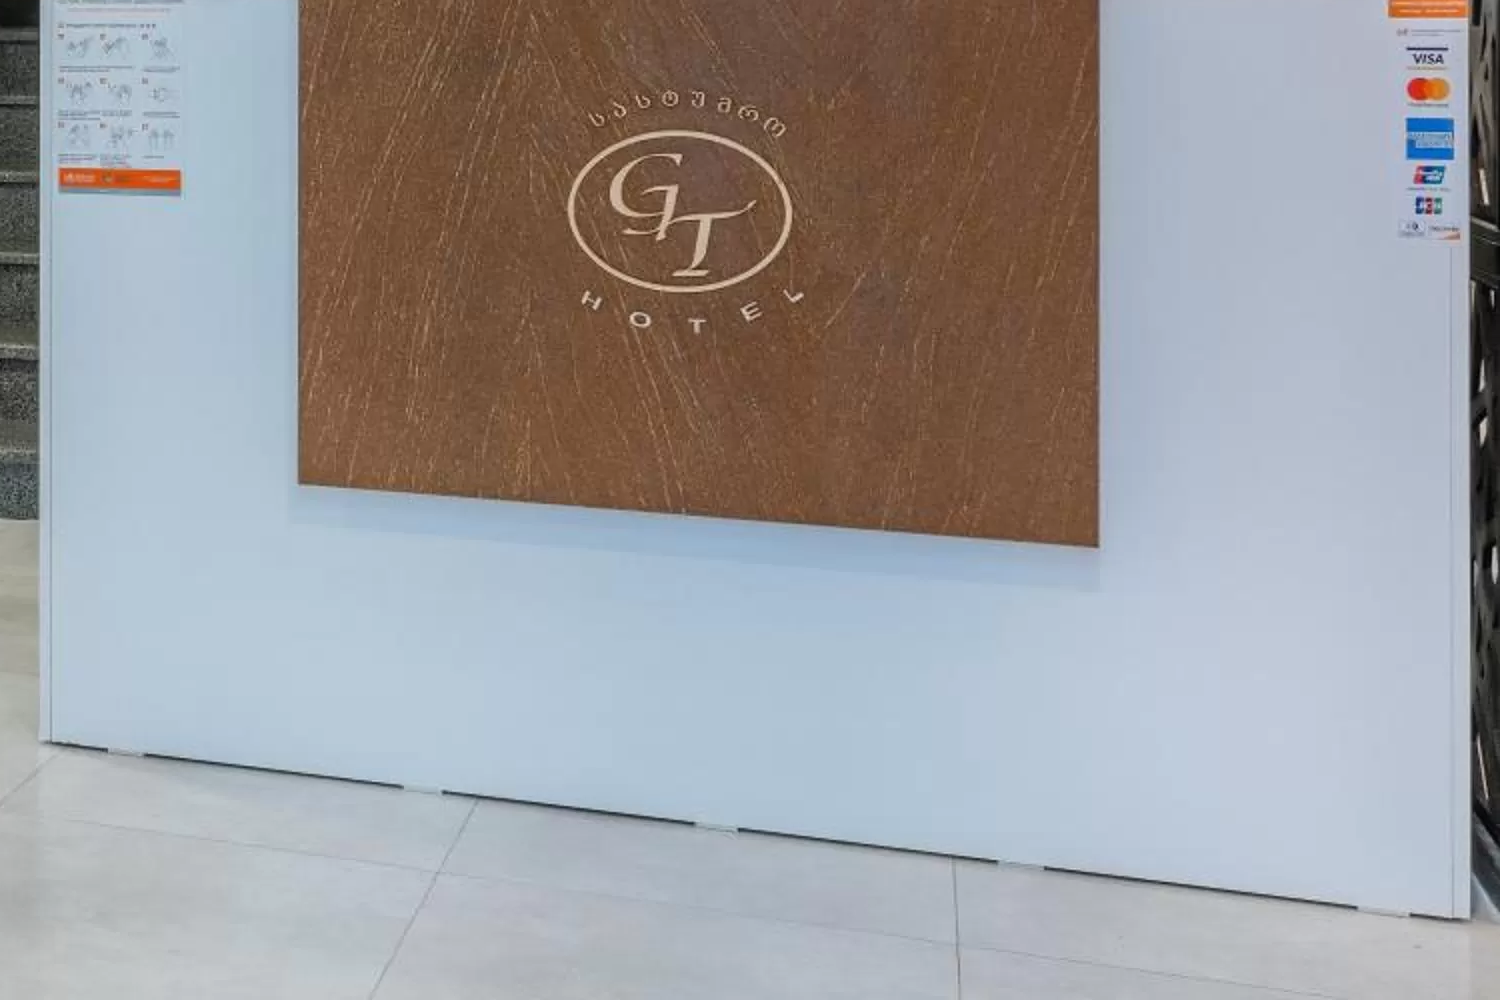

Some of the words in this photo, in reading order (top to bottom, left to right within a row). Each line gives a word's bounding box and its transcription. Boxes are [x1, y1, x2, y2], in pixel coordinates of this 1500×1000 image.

[1411, 53, 1444, 65] VISA
[587, 90, 788, 139] სასტუმრო
[580, 288, 805, 334] HOTEL
